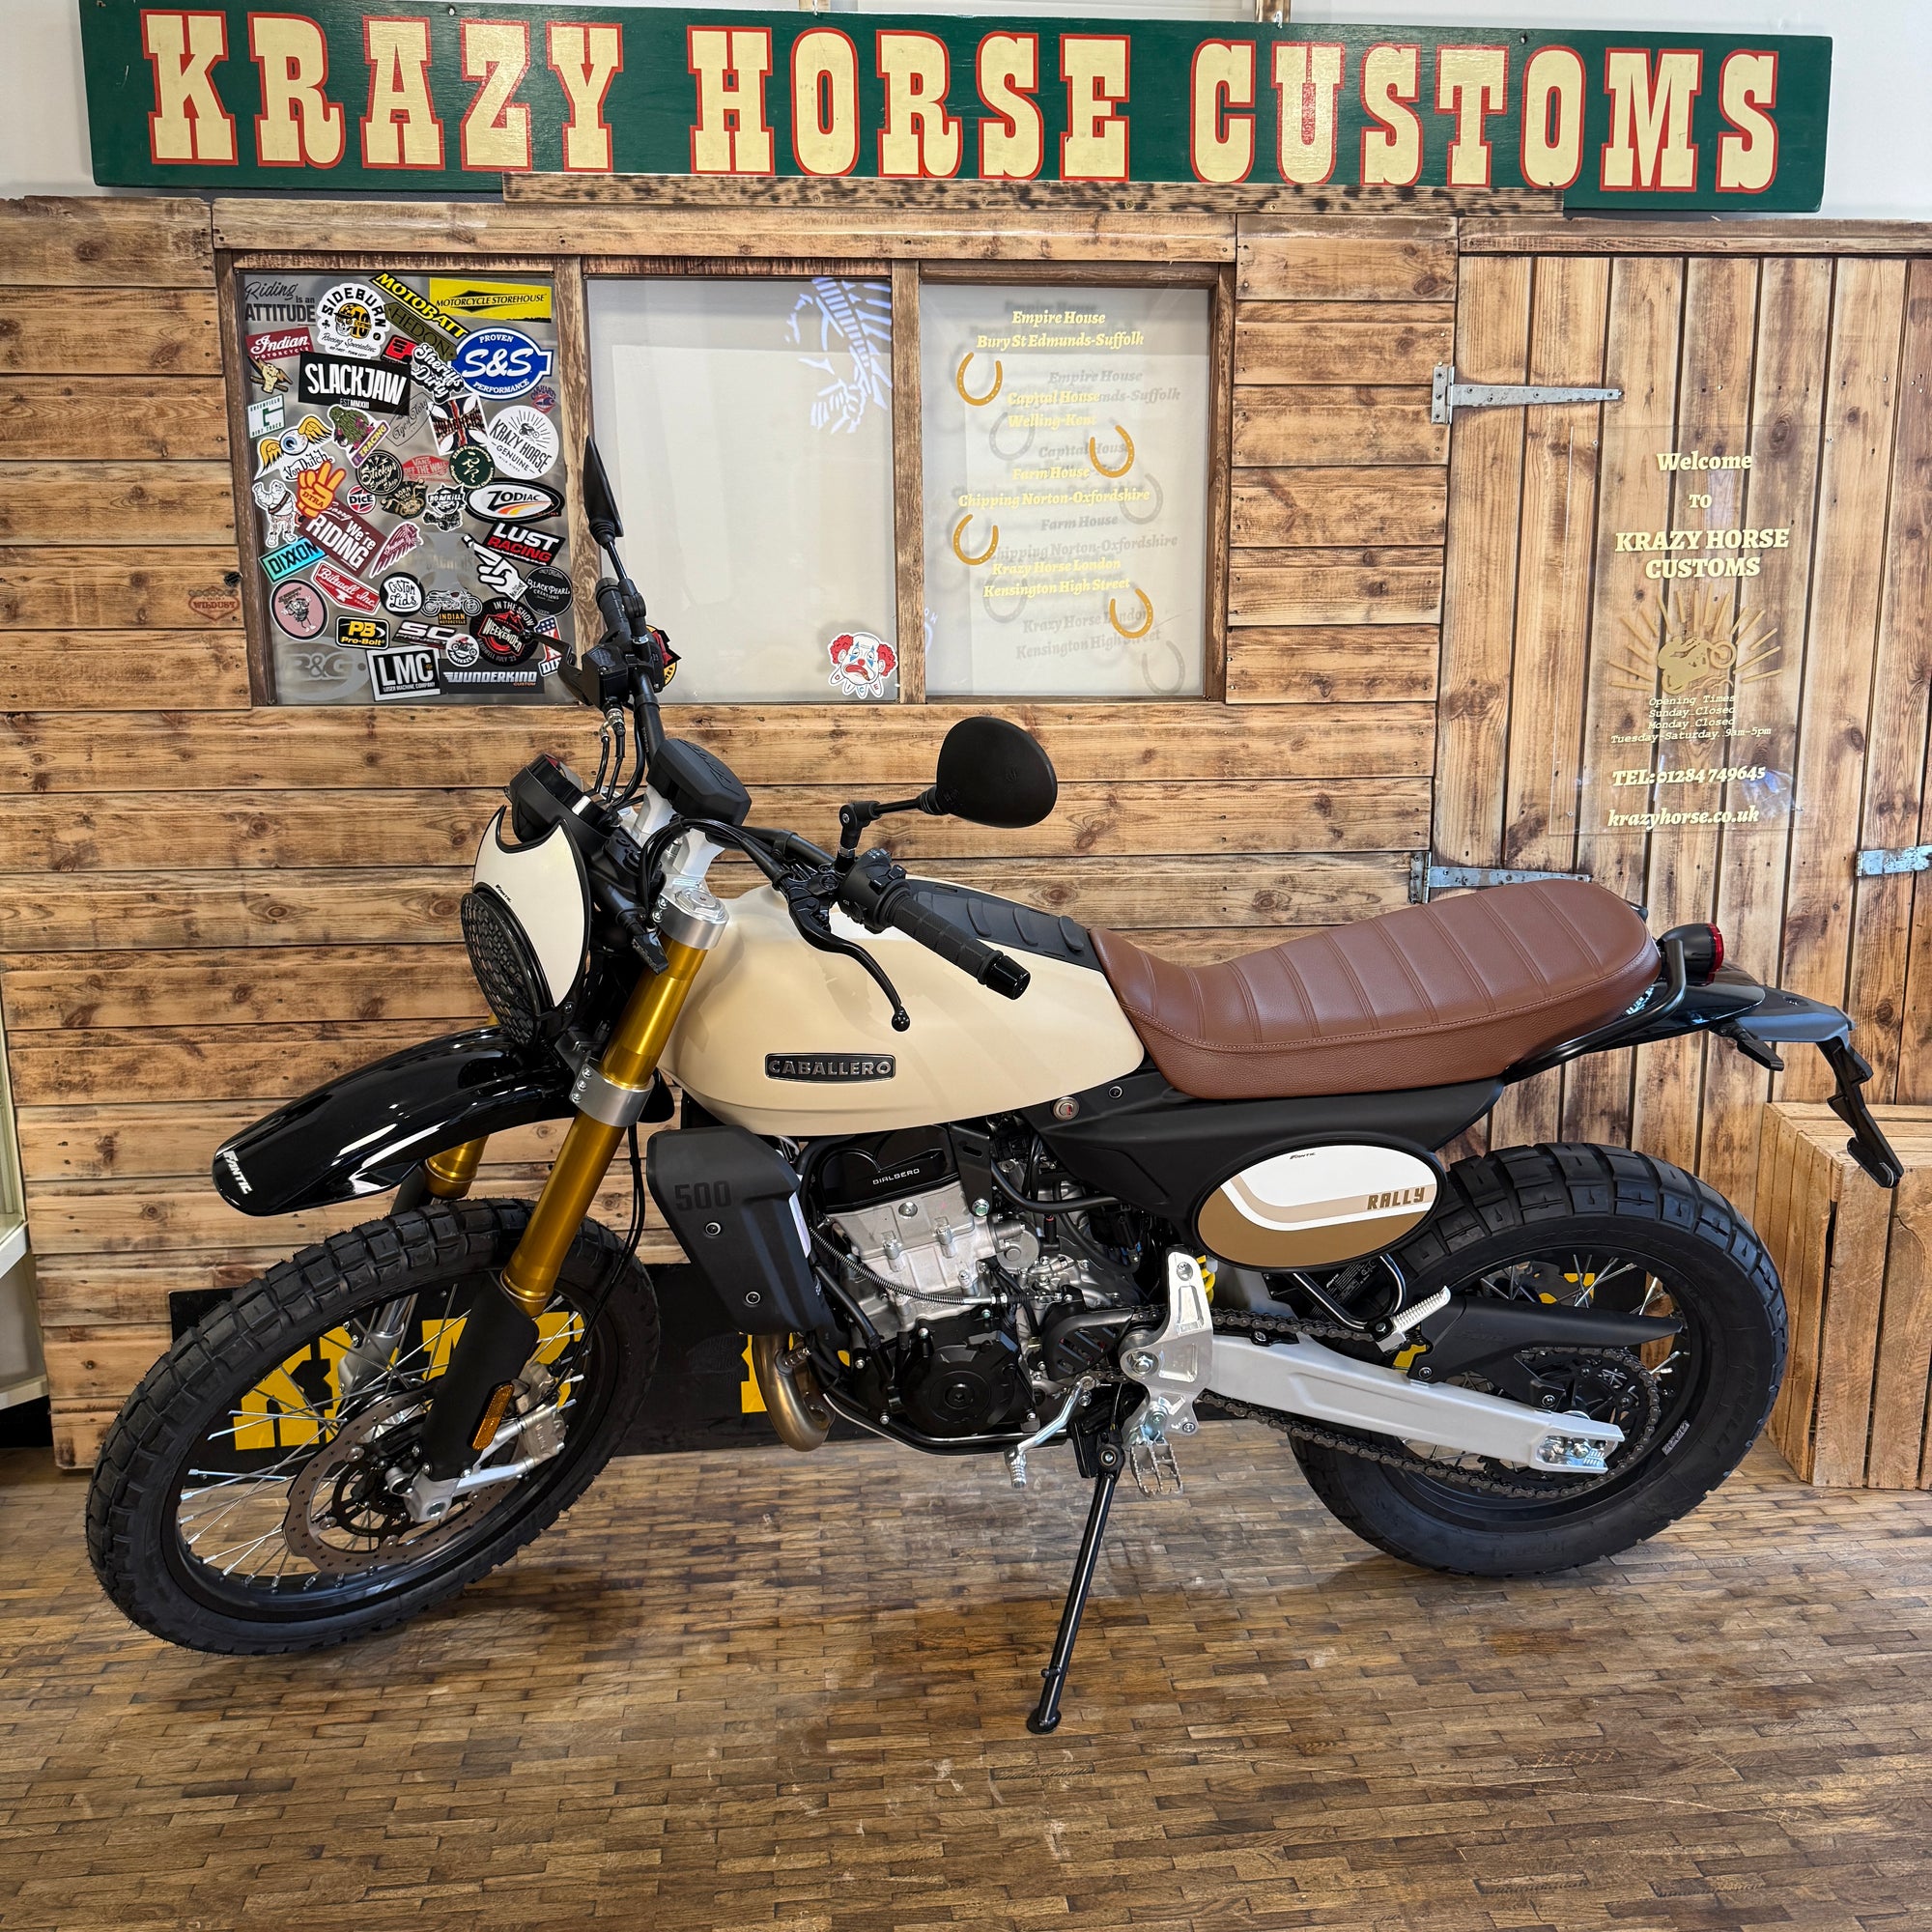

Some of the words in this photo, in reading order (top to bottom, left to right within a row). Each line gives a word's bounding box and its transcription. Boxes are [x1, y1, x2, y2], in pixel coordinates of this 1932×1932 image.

[141, 9, 623, 172] KRAZY
[687, 26, 1130, 182] HORSE
[1190, 39, 1778, 192] CUSTOMS
[244, 281, 298, 300] Riding
[436, 297, 491, 306] MOTORCYCLE
[492, 294, 545, 303] STOREHOUSE
[245, 303, 316, 322] ATTITUDE
[322, 288, 386, 327] SIDEBURN
[376, 272, 469, 337] MOTOBATT
[1012, 310, 1062, 327] Empire
[1064, 311, 1105, 324] House
[391, 308, 450, 355] HEDON
[479, 334, 514, 343] PROVEN
[977, 335, 1010, 351] Bury
[1012, 334, 1027, 348] St
[1028, 332, 1144, 349] Edmunds-Suffolk
[251, 335, 309, 355] Indian
[462, 349, 534, 378] S&S
[304, 363, 407, 405] SLACKJAW
[412, 366, 448, 398] Dirty
[473, 379, 530, 394] PERFORMANCE
[1007, 391, 1058, 407] Capital
[1060, 390, 1100, 404] House
[1008, 413, 1097, 430] Welling-Kent
[490, 418, 524, 449] KRAZY
[520, 442, 553, 473] HORSE
[283, 465, 300, 480] Von
[298, 449, 332, 471] Dutch
[497, 445, 529, 470] GENUINE
[1657, 450, 1752, 470] Welcome
[416, 465, 431, 474] THE
[1012, 469, 1049, 480] Farm
[1050, 467, 1091, 479] House
[301, 491, 324, 508] DTRA
[394, 487, 412, 497] BORN
[487, 491, 540, 511] ZODIAC
[958, 494, 1019, 511] Chipping
[1022, 488, 1150, 506] Norton-Oxfordshire
[1689, 495, 1713, 508] TO
[305, 514, 369, 569] RIDING
[345, 521, 377, 551] We're
[493, 523, 559, 551] LUST
[1615, 531, 1703, 552] KRAZY
[1705, 528, 1789, 550] HORSE
[267, 541, 320, 575] DIXXON
[487, 537, 552, 562] RACING
[992, 561, 1031, 577] Krazy
[1034, 560, 1071, 573] Horse
[1074, 557, 1121, 571] London
[1645, 557, 1760, 579] CUSTOMS
[317, 567, 357, 595] Biltwell
[388, 581, 415, 595] CUSTOM
[983, 582, 1056, 598] Kensington
[1060, 581, 1090, 594] High
[1093, 578, 1130, 591] Street
[389, 593, 417, 609] Lids
[493, 601, 502, 611] IN
[503, 601, 517, 611] THE
[516, 606, 535, 628] SHOW
[349, 620, 377, 638] PB
[398, 621, 455, 641] SC
[482, 618, 523, 653] WEEKENDER
[340, 637, 383, 646] Pro-Bolt
[378, 653, 434, 687] LMC
[443, 671, 537, 683] WUNDERKIND
[1649, 696, 1696, 706] Opening
[1703, 695, 1736, 703] Times
[1708, 766, 1766, 782] 749645
[1607, 805, 1760, 830] krazyhorse.co.uk
[769, 1061, 892, 1075] CABALLERO
[223, 1151, 253, 1195] FANTIC
[872, 1168, 921, 1185] BIALBERO
[675, 1180, 732, 1209] 500
[1367, 1187, 1425, 1210] RALLY
